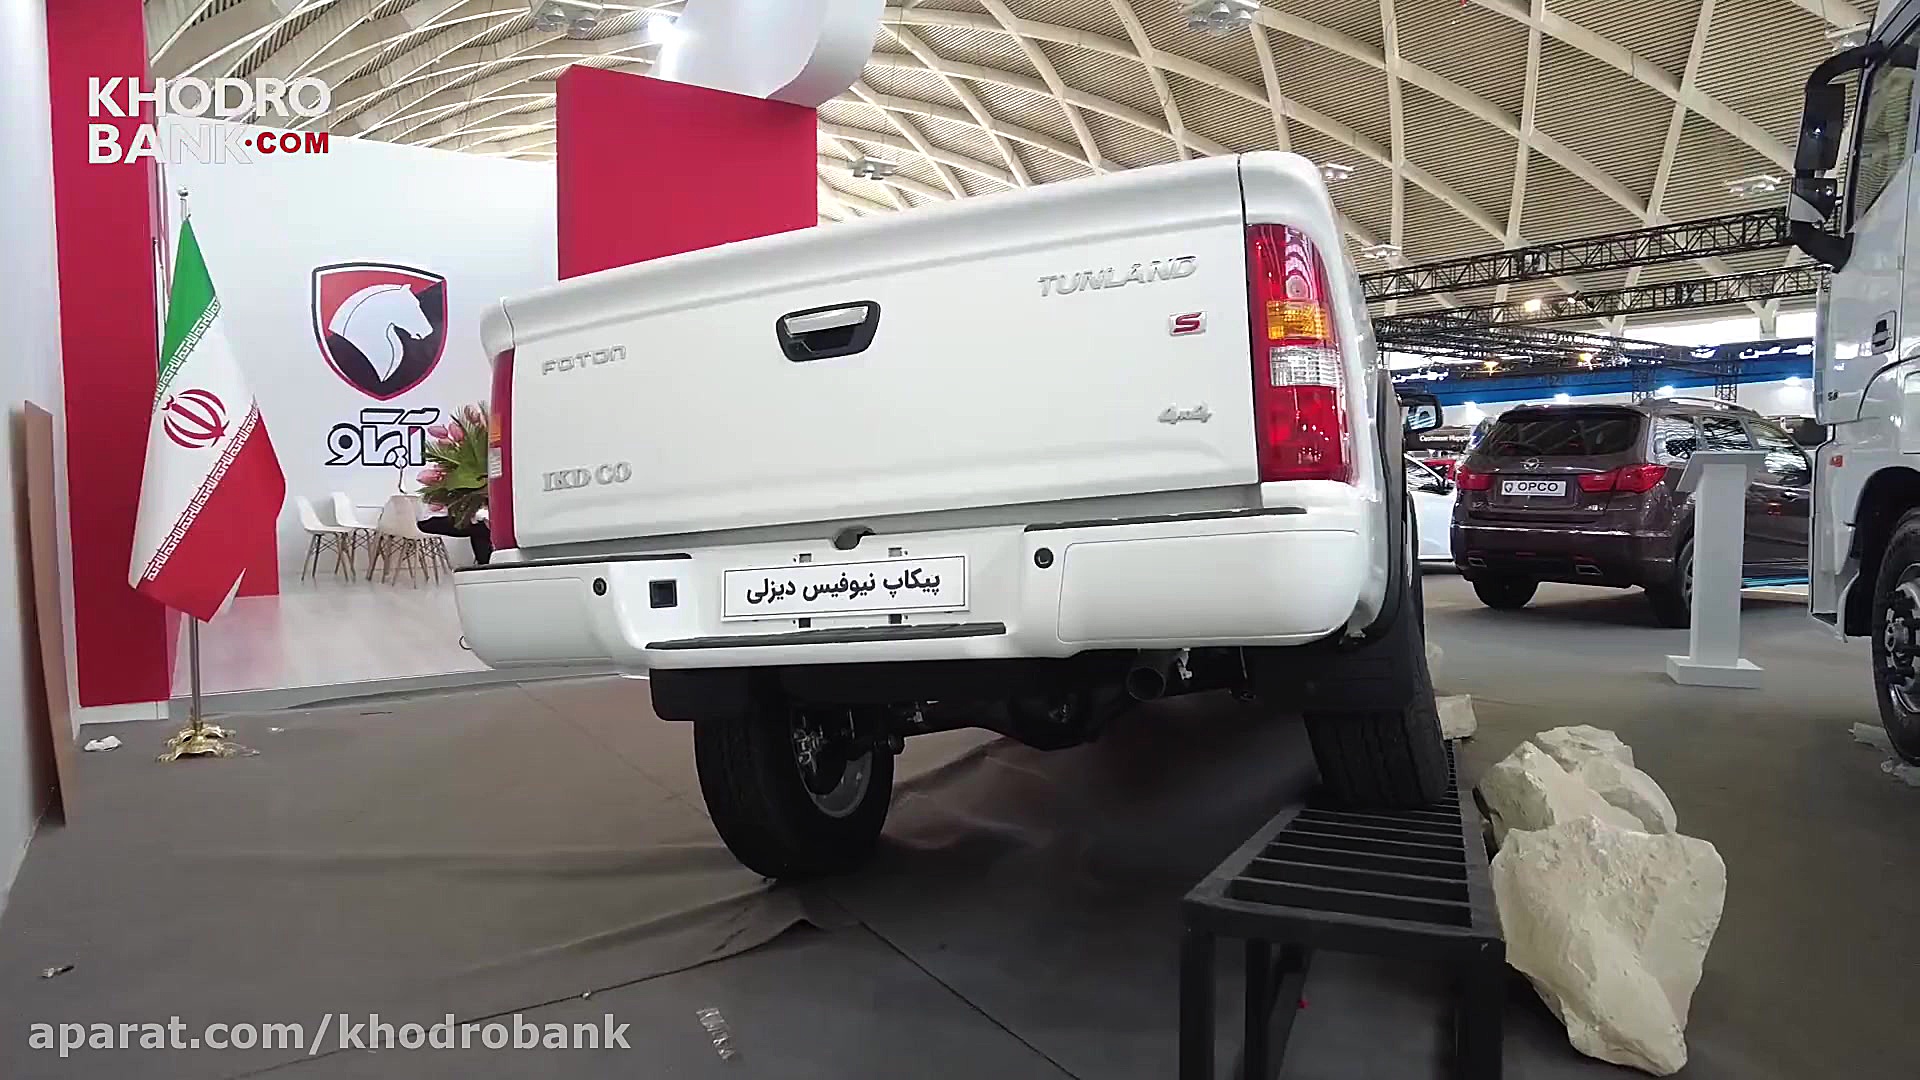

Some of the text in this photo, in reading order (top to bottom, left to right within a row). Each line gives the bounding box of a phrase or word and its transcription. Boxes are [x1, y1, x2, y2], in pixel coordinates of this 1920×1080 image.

[1037, 254, 1200, 297] TUNLAND
[1172, 311, 1203, 334] S
[541, 344, 627, 376] FOTON
[542, 460, 633, 492] IKD CO
[1517, 481, 1559, 492] OPCO
[746, 567, 941, 604] پیکاپ نیوفیس دیزلی
